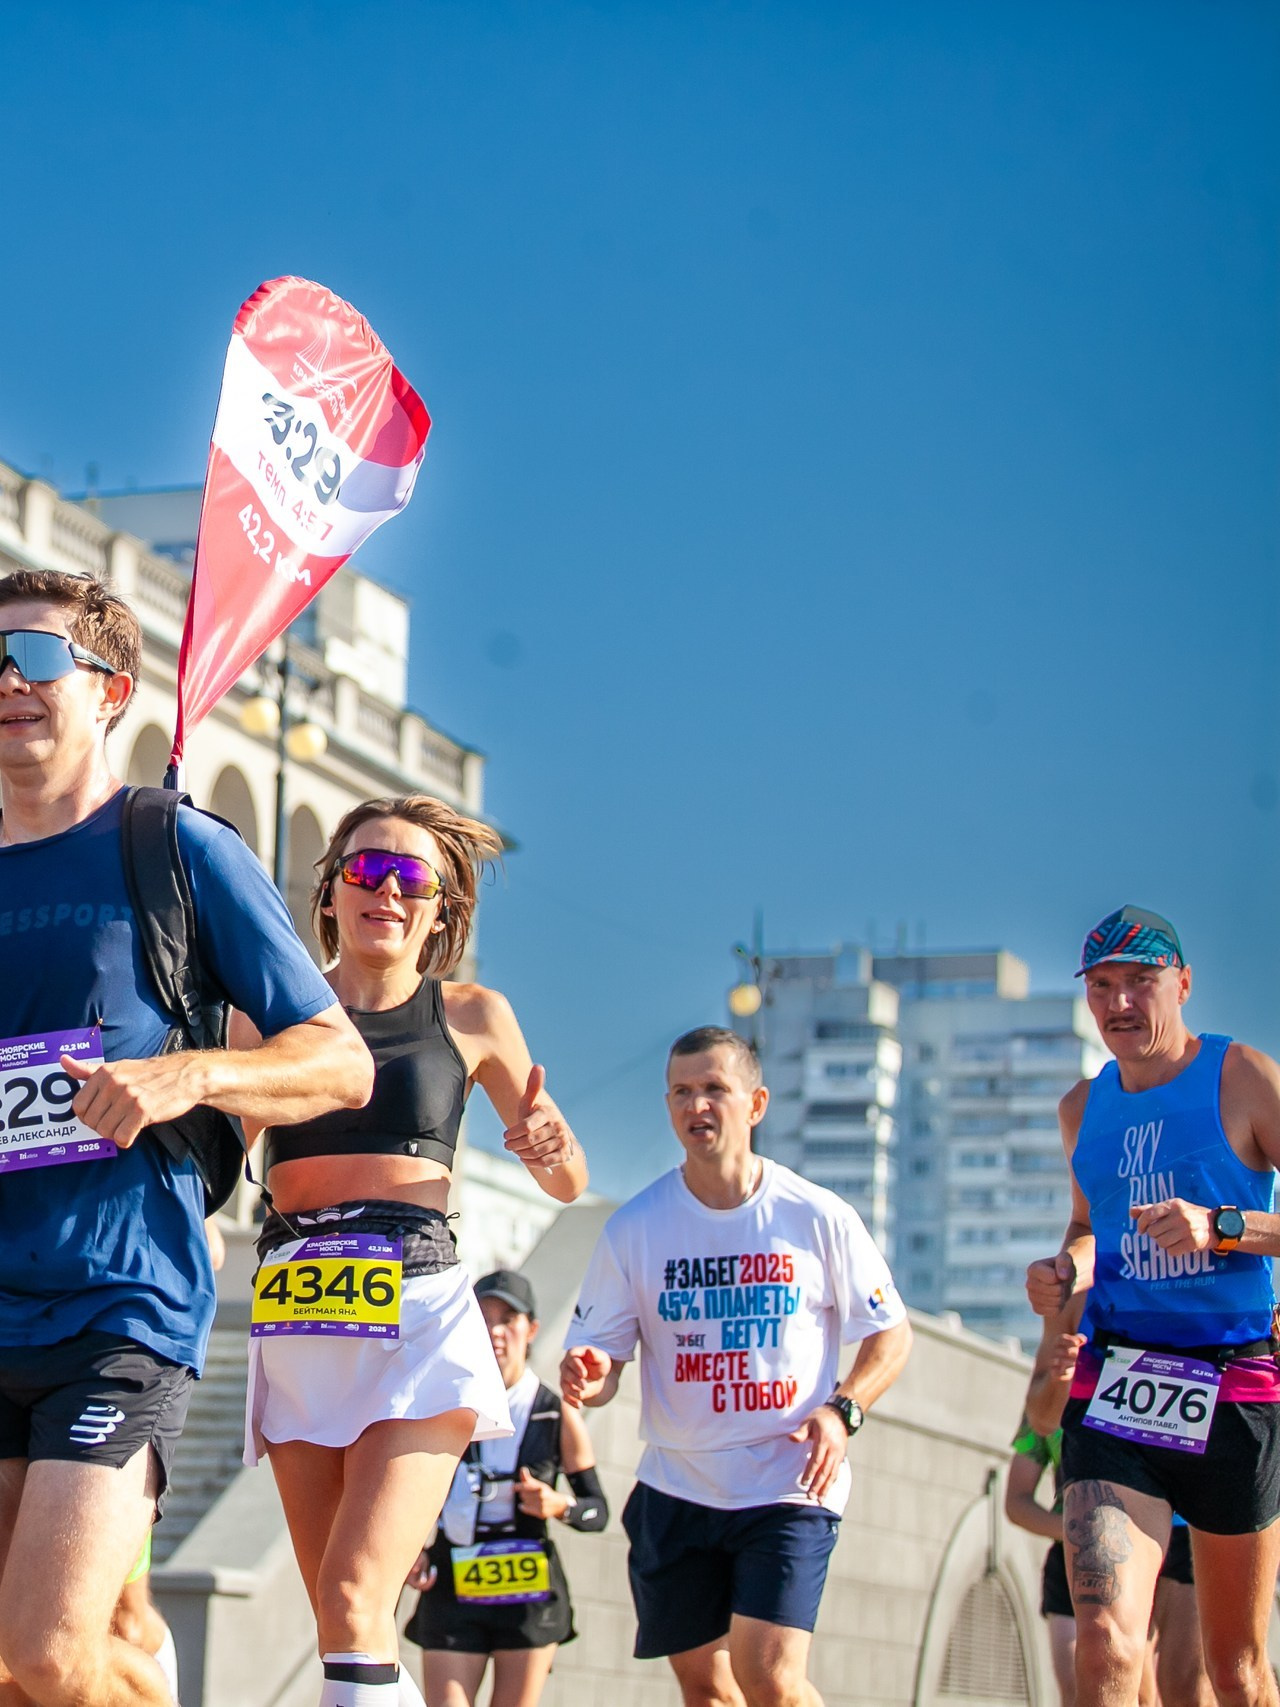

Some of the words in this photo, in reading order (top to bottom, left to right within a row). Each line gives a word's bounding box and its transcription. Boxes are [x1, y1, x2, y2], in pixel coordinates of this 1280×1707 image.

[261, 392, 341, 505] 3:29
[238, 503, 275, 564] 42,2
[0, 1052, 29, 1062] МОСТЫ
[59, 1043, 76, 1052] 42,2
[77, 1041, 90, 1050] КМ
[10, 1126, 77, 1143] АЛЕКСАНДР
[78, 1143, 100, 1152] 2026
[1117, 1120, 1164, 1178] SKY
[307, 1240, 358, 1248] КРАСНОЯРСКИЕ
[259, 1265, 395, 1307] 4346
[664, 1253, 794, 1290] #ЗАБЕГ2025
[293, 1306, 337, 1315] БЕЙТМАН
[658, 1290, 701, 1322] 45%
[704, 1285, 801, 1320] ПЛАНЕТЫ
[722, 1318, 781, 1350] БЕГУТ
[675, 1351, 750, 1382] ВМЕСТЕ
[712, 1384, 725, 1413] С
[730, 1375, 798, 1411] ТОБОЙ
[1099, 1376, 1209, 1424] 4076
[1118, 1414, 1152, 1426] АНТИПОВ
[1153, 1420, 1178, 1430] ПАВЕЛ
[463, 1557, 538, 1586] 4319
